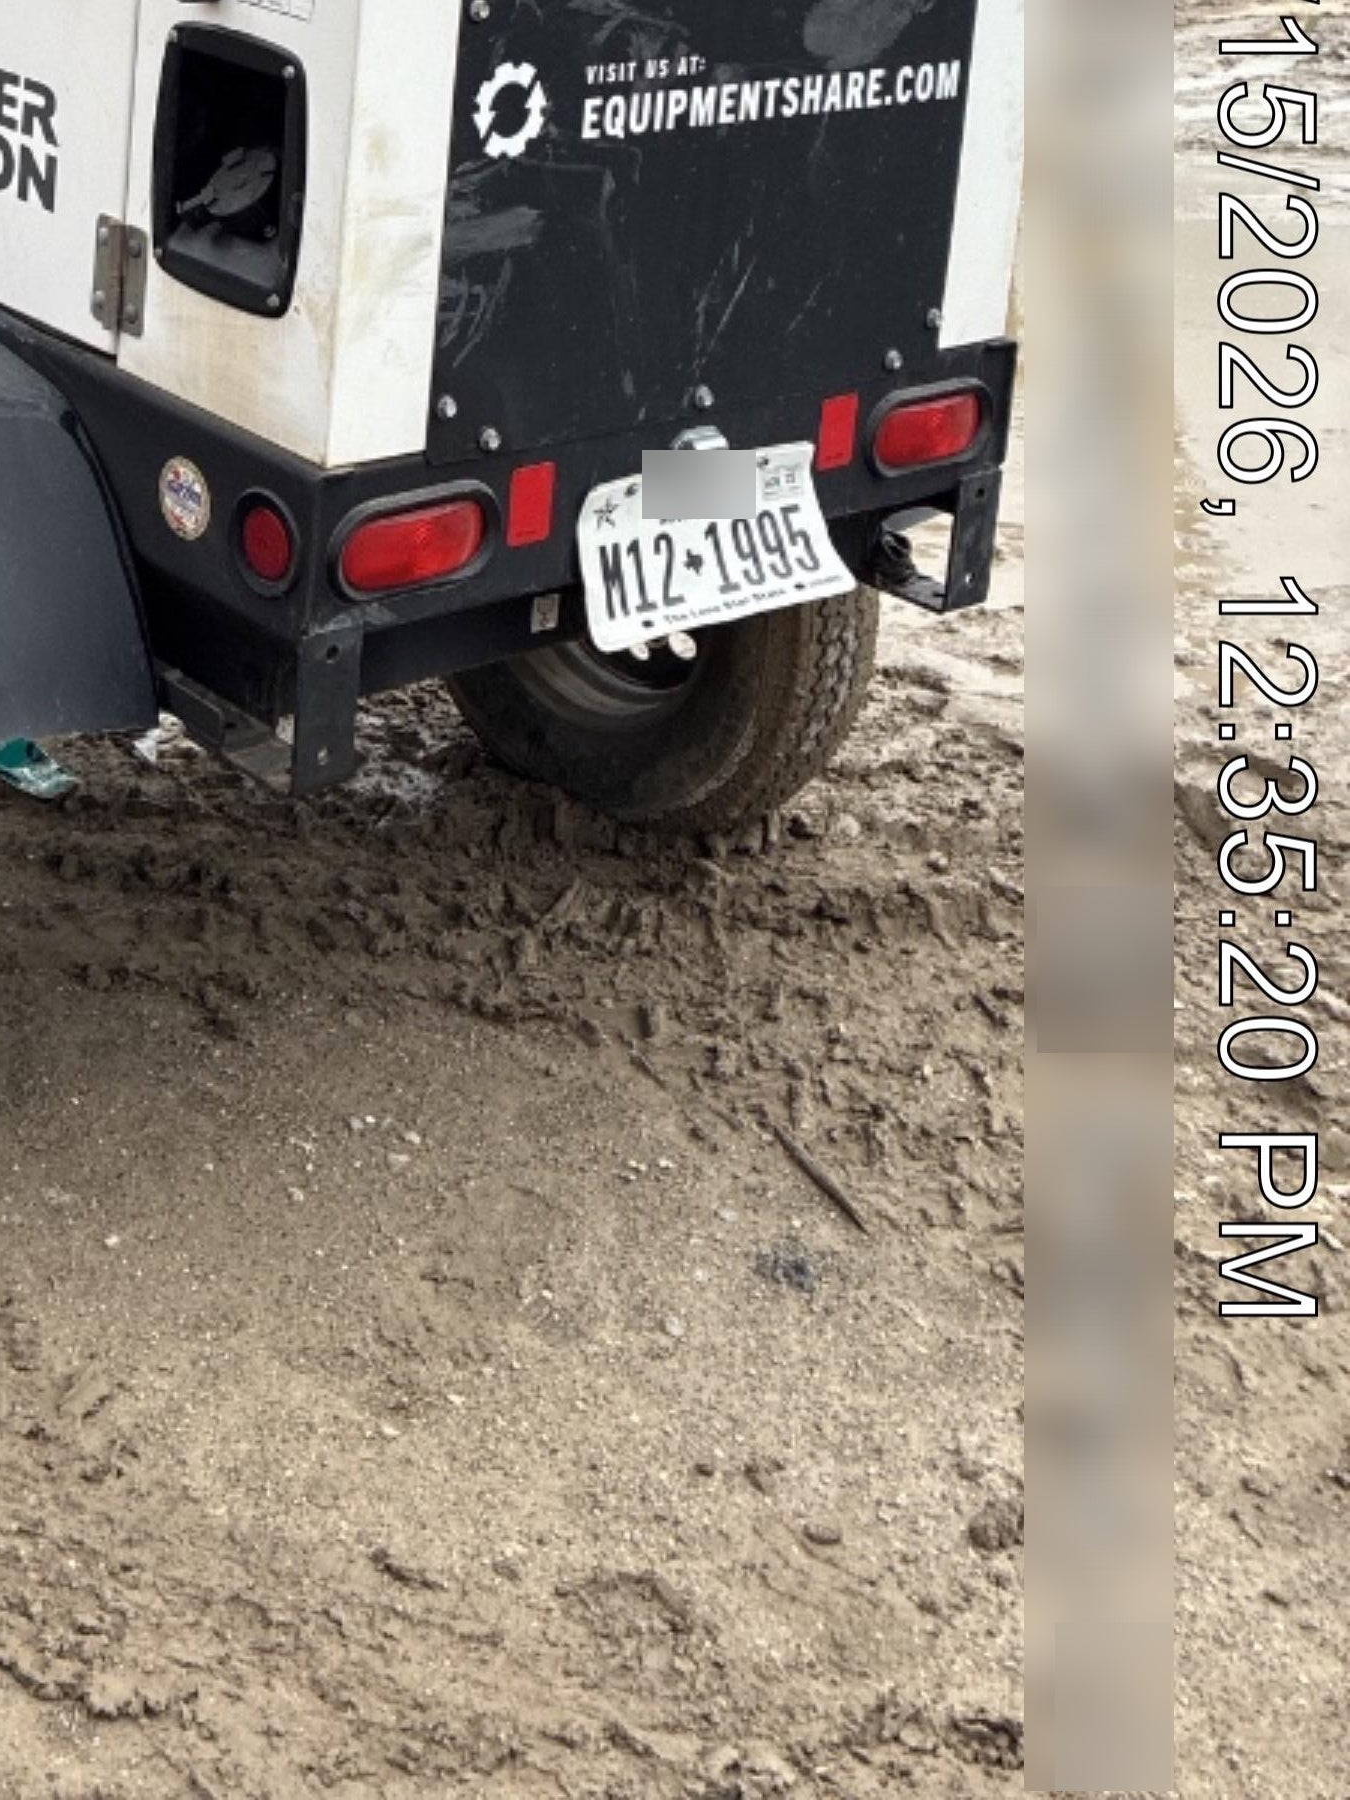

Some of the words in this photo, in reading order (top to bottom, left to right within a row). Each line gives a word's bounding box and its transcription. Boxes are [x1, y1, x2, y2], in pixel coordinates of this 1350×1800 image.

[585, 60, 637, 85] VISIT
[644, 57, 670, 80] US
[676, 54, 707, 77] AT:
[580, 59, 962, 140] EQUIPMENTSHARE.COM
